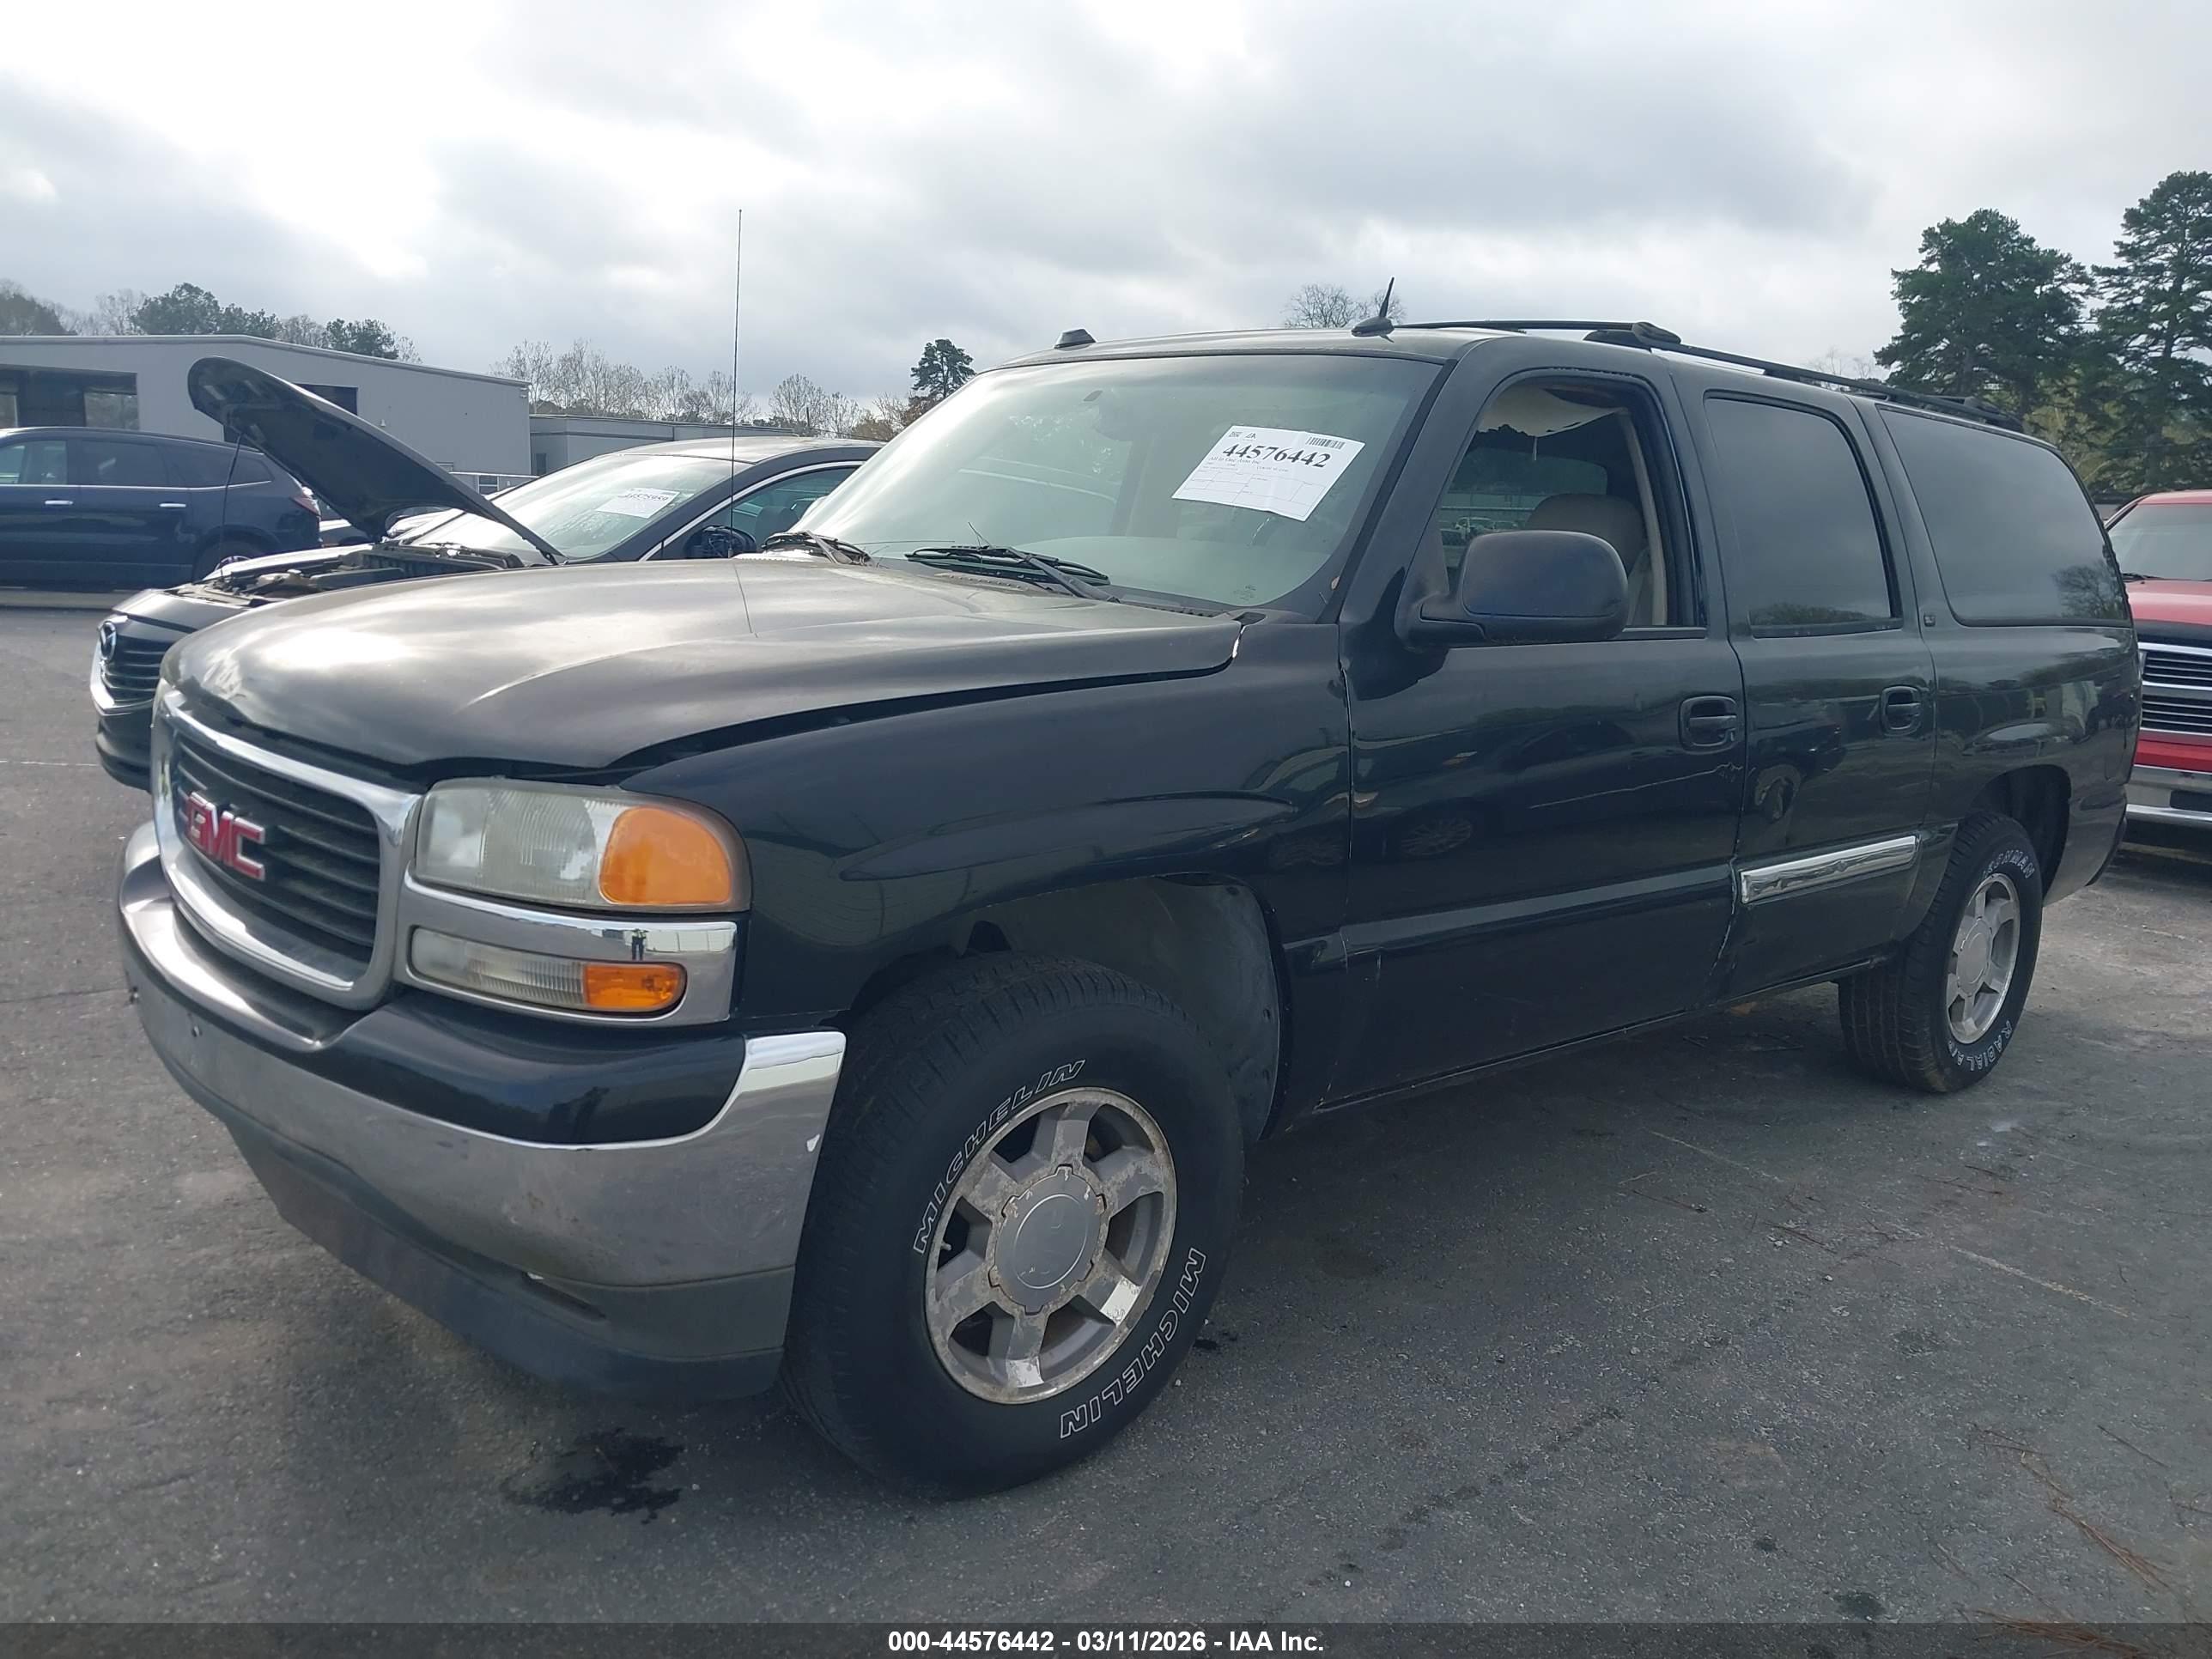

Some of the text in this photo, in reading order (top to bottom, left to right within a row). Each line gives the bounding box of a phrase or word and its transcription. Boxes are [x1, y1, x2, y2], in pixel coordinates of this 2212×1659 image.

[1223, 444, 1331, 467] 44576442
[185, 791, 264, 880] GMC
[1966, 1019, 2013, 1072] RADIAL
[913, 1059, 1086, 1254] MICHELIN
[1060, 1247, 1206, 1439] MICHELIN
